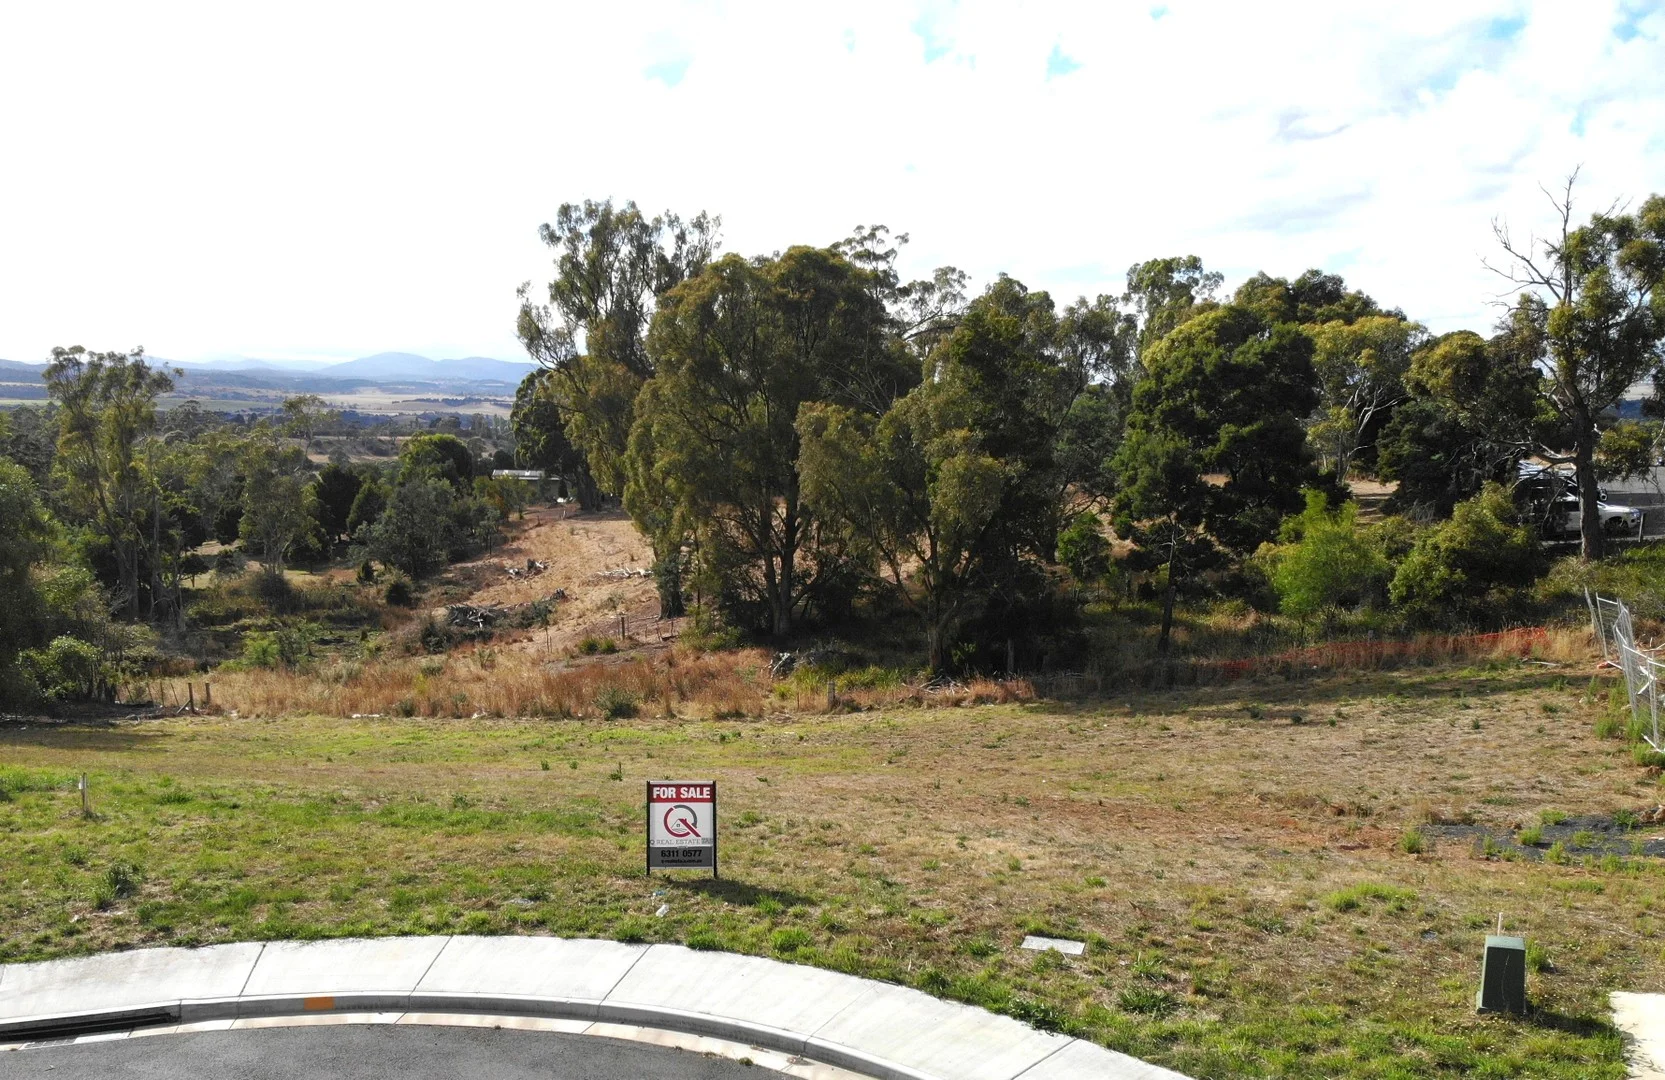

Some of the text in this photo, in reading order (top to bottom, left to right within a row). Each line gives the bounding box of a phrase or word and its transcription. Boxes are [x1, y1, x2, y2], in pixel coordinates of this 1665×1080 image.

[653, 787, 711, 798] FOR SALE
[661, 849, 702, 857] 6311 0577
